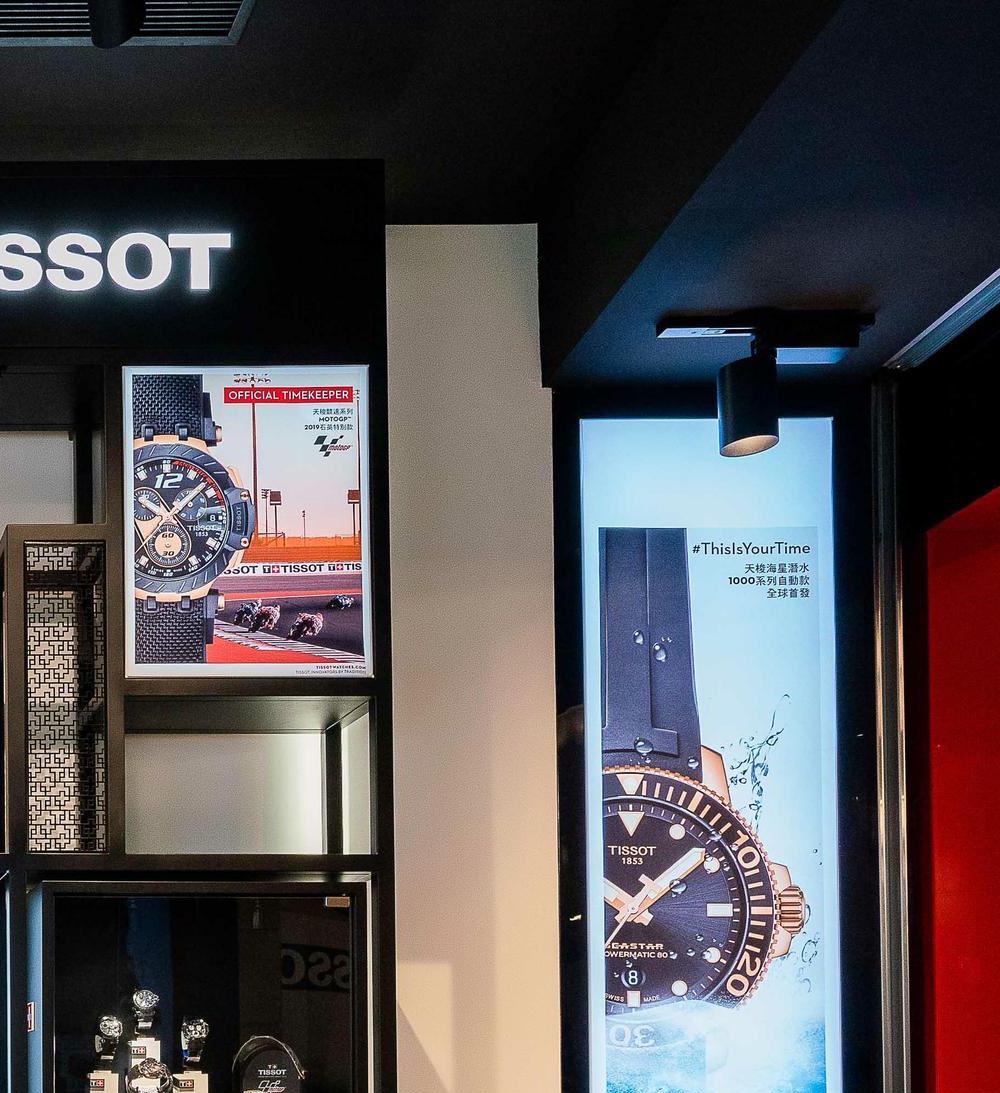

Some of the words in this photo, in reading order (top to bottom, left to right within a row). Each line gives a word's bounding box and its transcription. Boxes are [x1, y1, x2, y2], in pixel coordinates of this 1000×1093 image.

[228, 390, 279, 400] OFFICIAL
[282, 389, 349, 400] TIMEKEEPER
[155, 473, 184, 489] 12
[692, 541, 811, 555] #ThisIsYourTime
[281, 563, 324, 573] TISSOT
[728, 575, 810, 586] 1000系列自動款
[766, 587, 811, 599] 全球首發
[607, 845, 657, 856] TISSOT
[735, 829, 761, 869] 10
[621, 857, 644, 865] 1853
[628, 970, 638, 985] 8
[726, 952, 762, 997] 20
